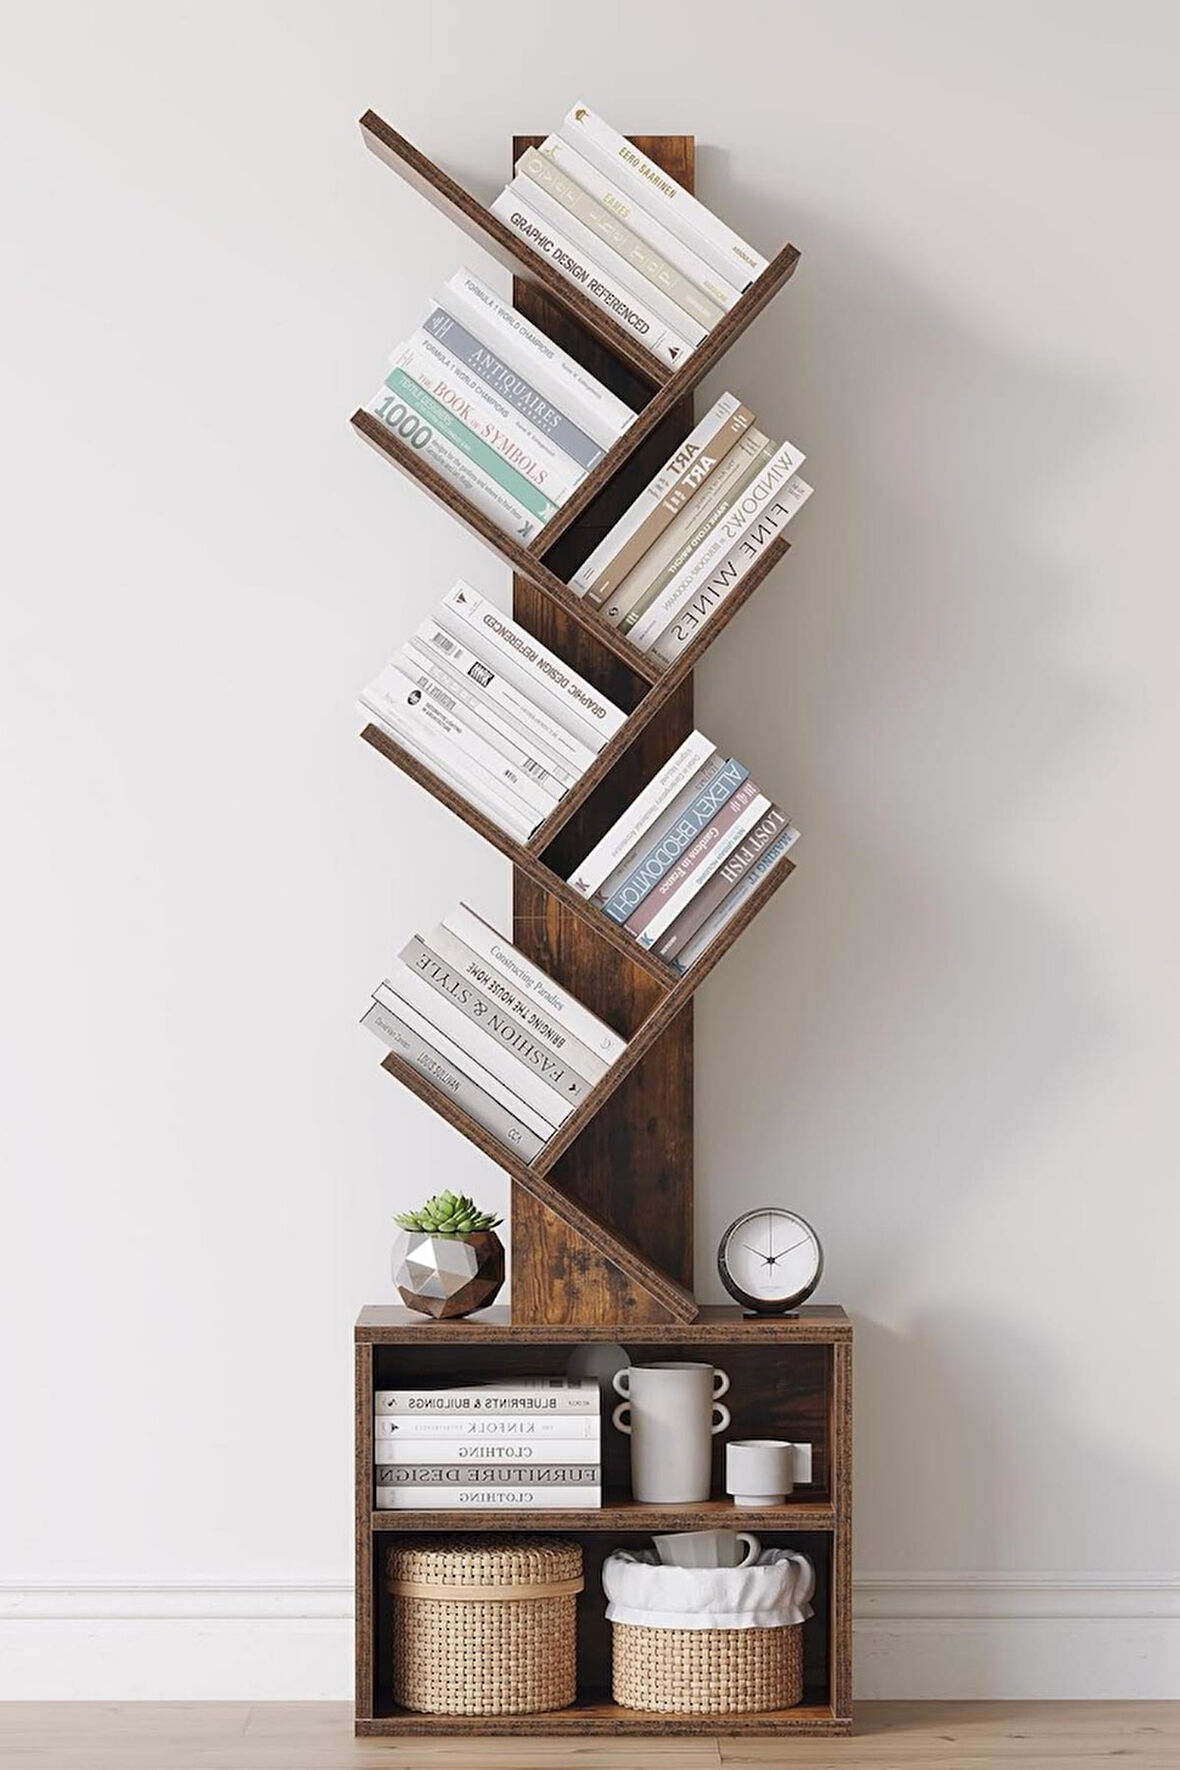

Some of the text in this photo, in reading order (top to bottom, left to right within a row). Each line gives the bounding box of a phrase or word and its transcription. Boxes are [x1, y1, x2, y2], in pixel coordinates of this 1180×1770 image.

[618, 147, 675, 198] EERO SAARINEN
[602, 192, 630, 218] EAMES
[509, 211, 650, 335] GRAPHIC DESIGN REFERENCED
[464, 279, 494, 306] FORMULA
[497, 308, 520, 330] WORLD
[518, 327, 554, 359] CHAMPIONS
[421, 340, 450, 366] FORMULA
[453, 368, 476, 389] WORLD
[474, 385, 509, 417] CHAMPIONS
[470, 347, 562, 429] ANTIQUAIRES
[373, 393, 435, 451] 1000
[432, 380, 474, 420] BOOK
[480, 422, 549, 485] SYMBOLS
[481, 613, 538, 662] REFERENCED
[535, 658, 569, 688] DESIGN
[567, 684, 607, 719] GRAPHIC
[689, 764, 743, 824] ALEXEY
[731, 826, 746, 842] NEW
[745, 809, 784, 851] LOST
[745, 832, 791, 886] MAKING IT
[614, 820, 697, 915] BRODOVITCH
[658, 825, 719, 896] Gardens in France
[719, 845, 754, 882] FISH
[488, 945, 536, 987] Constructing
[415, 953, 564, 1081] FASHION & STYLE
[464, 961, 565, 1048] BRINGING THE HOUSE HOME
